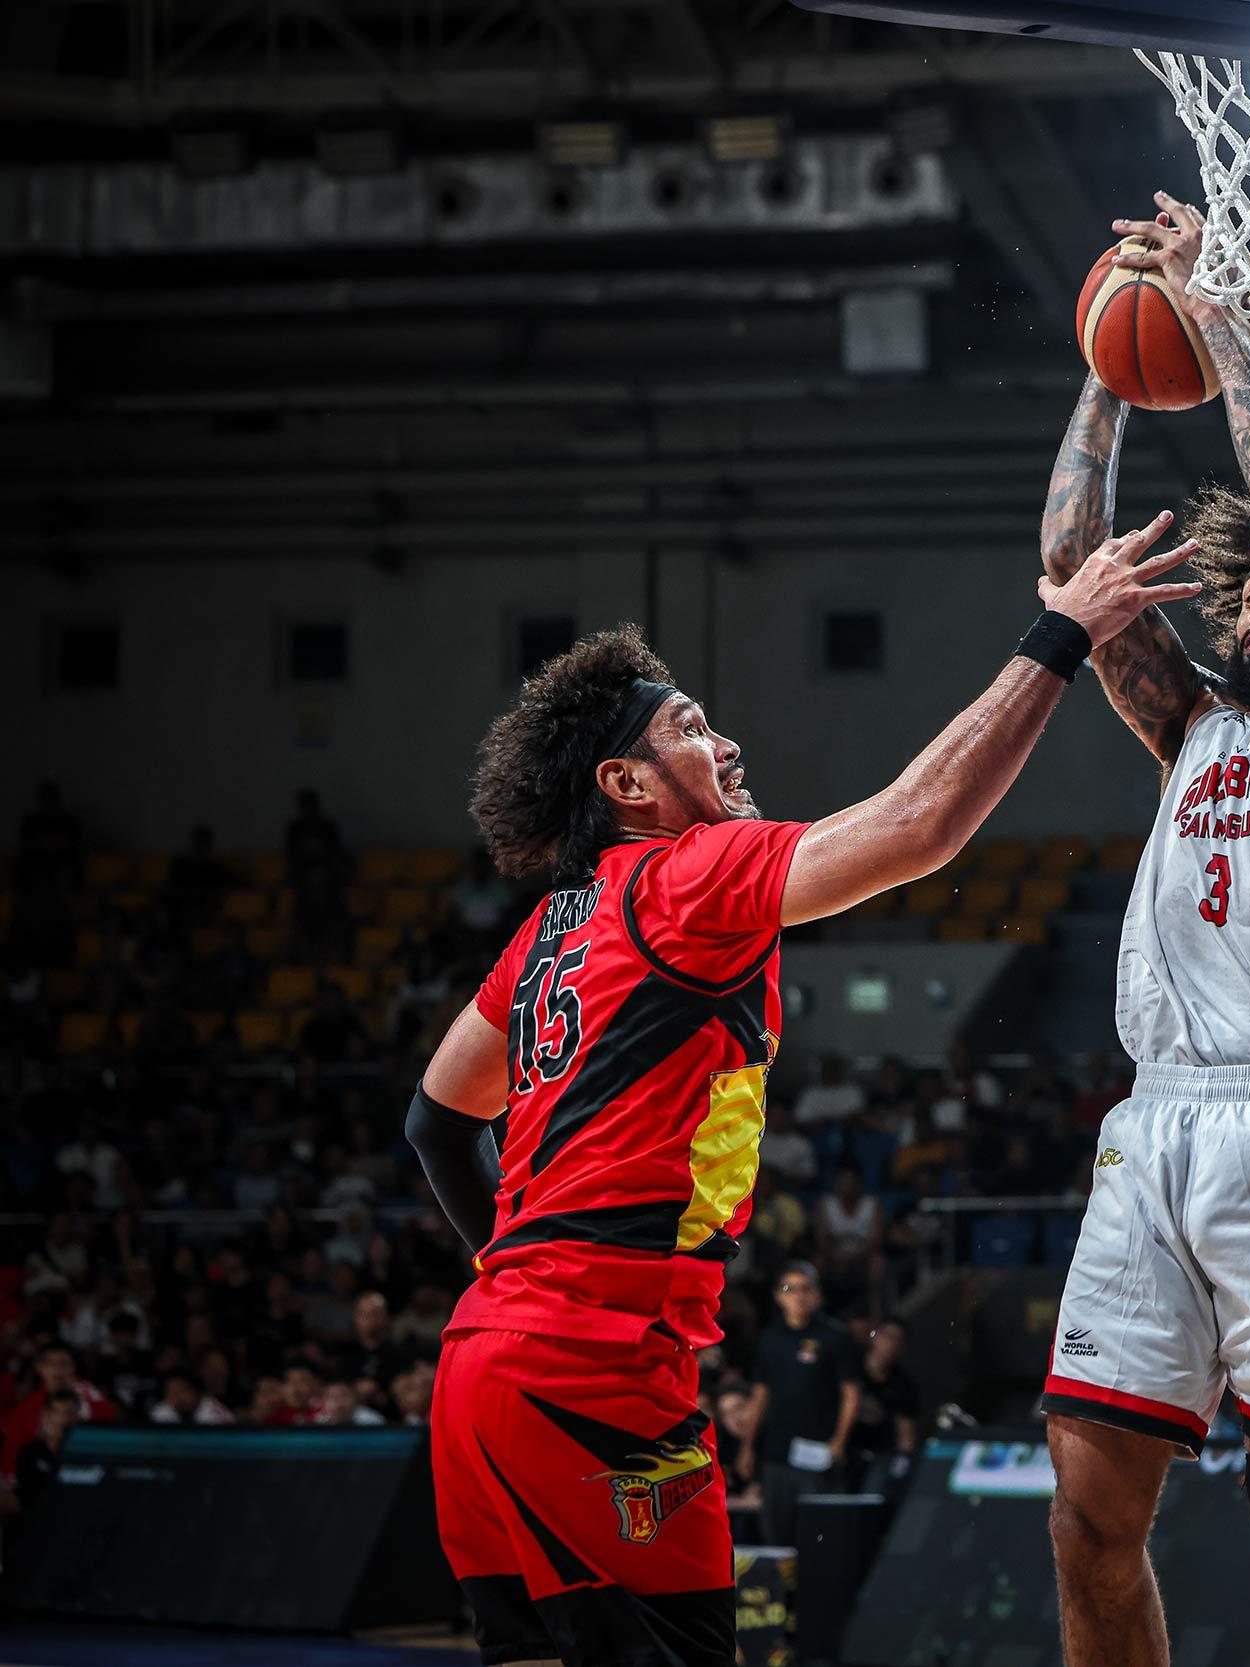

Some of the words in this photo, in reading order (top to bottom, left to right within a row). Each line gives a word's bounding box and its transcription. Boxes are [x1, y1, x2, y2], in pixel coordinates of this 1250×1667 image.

[1199, 853, 1232, 927] 3
[512, 939, 592, 1096] 15
[1064, 1342, 1094, 1350] WORLD
